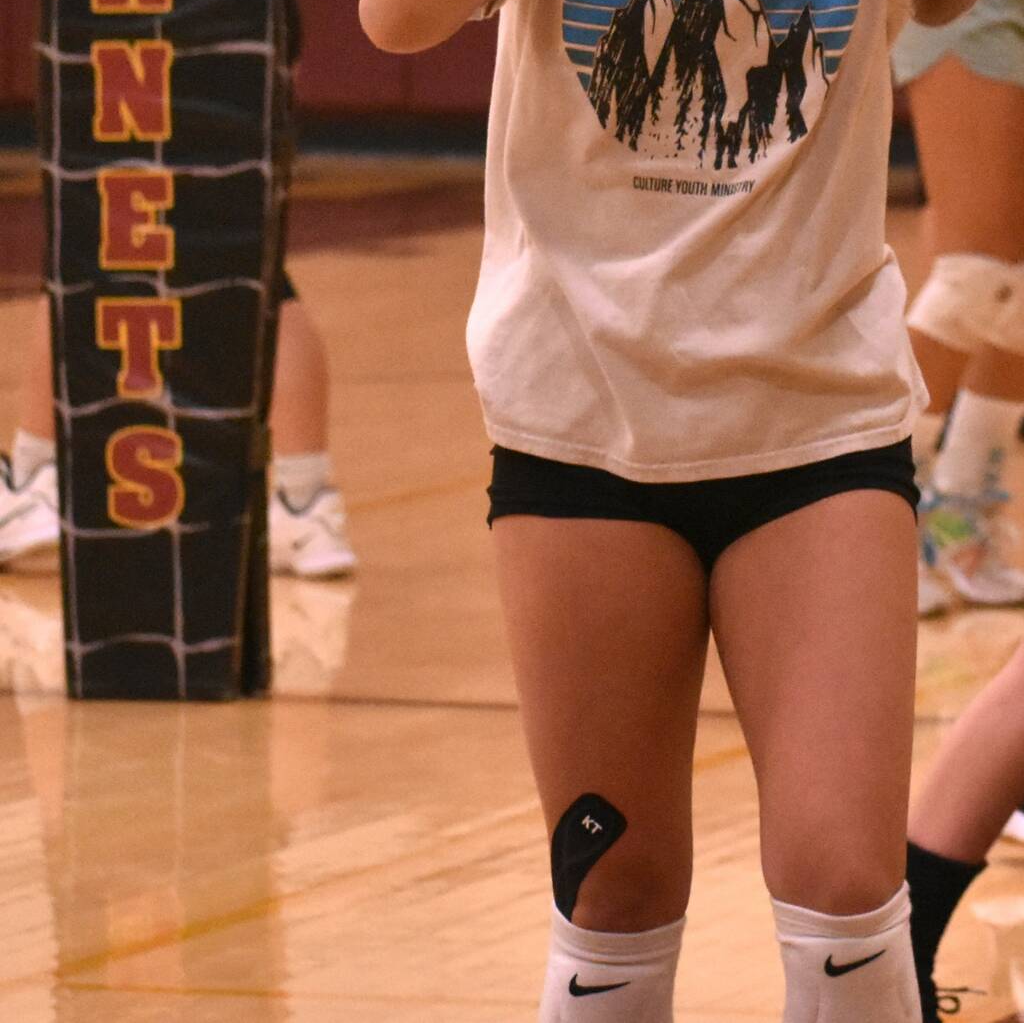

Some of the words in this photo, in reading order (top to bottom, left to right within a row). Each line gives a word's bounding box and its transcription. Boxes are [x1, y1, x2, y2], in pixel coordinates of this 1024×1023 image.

[632, 175, 673, 193] CULTURE
[675, 180, 708, 196] YOUTH
[710, 179, 756, 197] MINISTRY
[581, 814, 603, 834] KT
